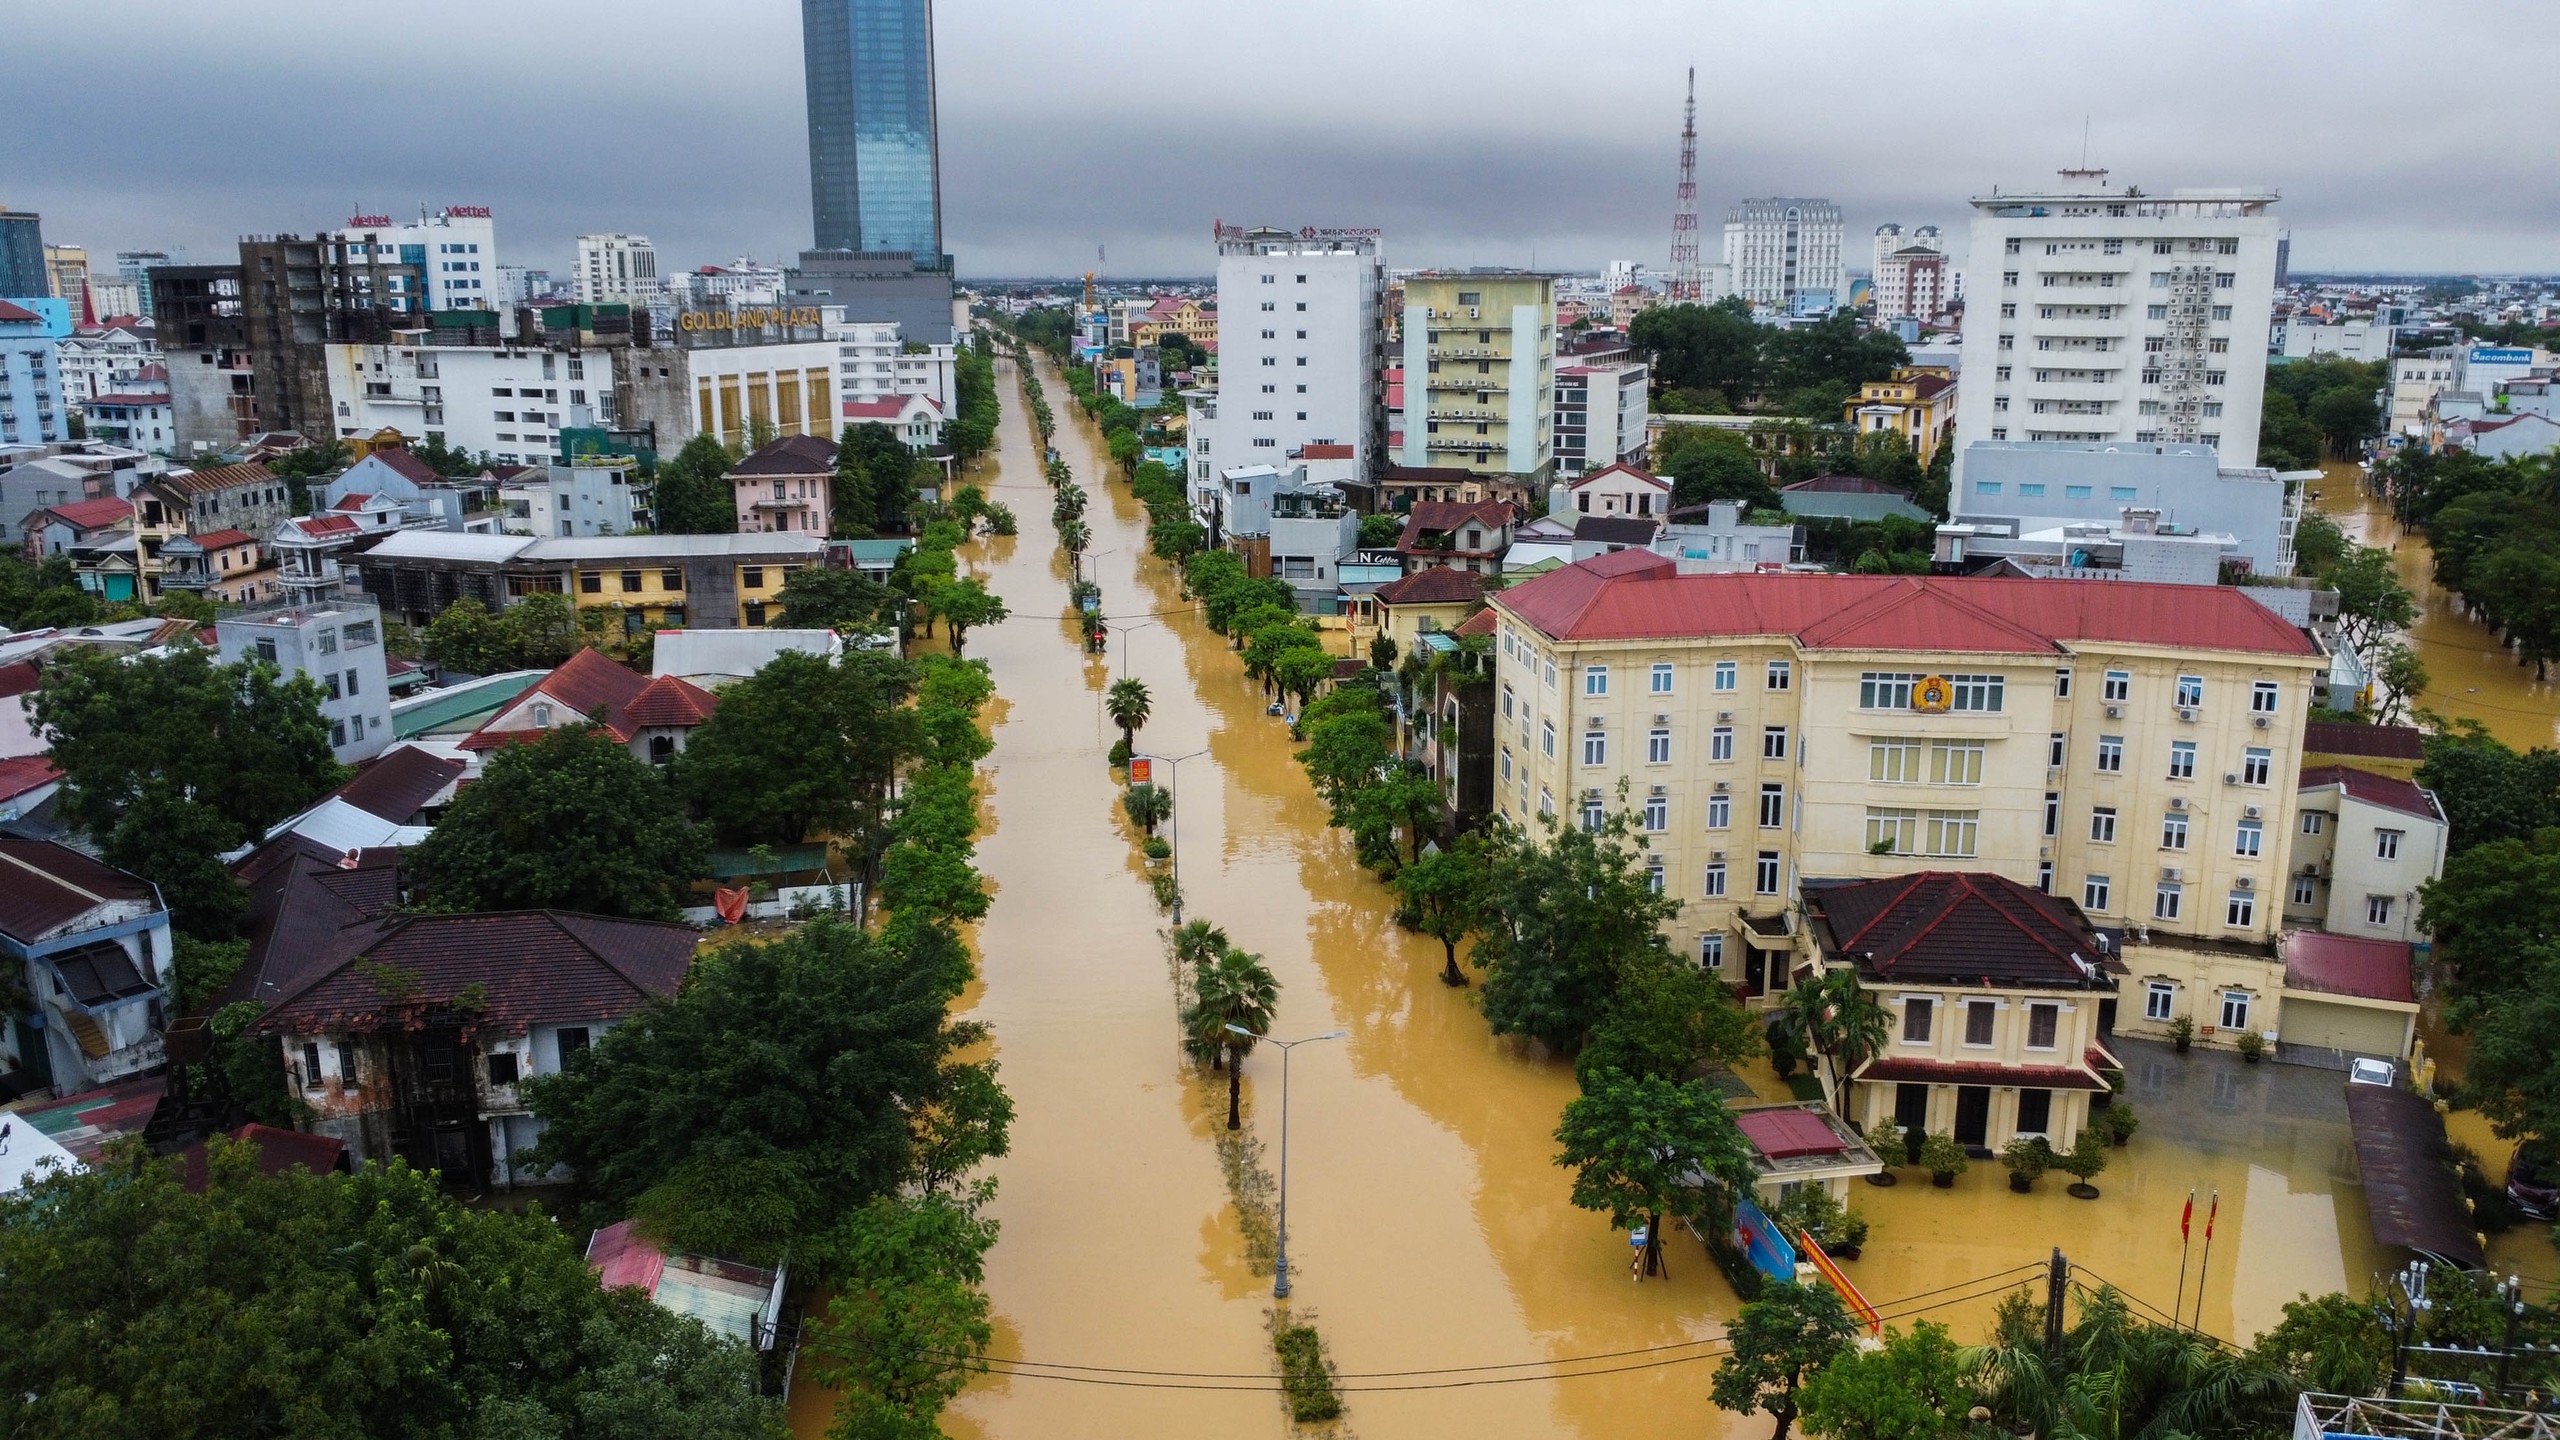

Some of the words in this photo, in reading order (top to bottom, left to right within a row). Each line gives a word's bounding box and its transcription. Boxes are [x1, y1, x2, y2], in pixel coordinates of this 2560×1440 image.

[681, 309, 767, 331] GOLDLAND
[770, 307, 820, 328] PLAZA
[2471, 351, 2531, 363] Sacombank
[1360, 552, 1371, 563] N
[1374, 554, 1399, 566] Coffee
